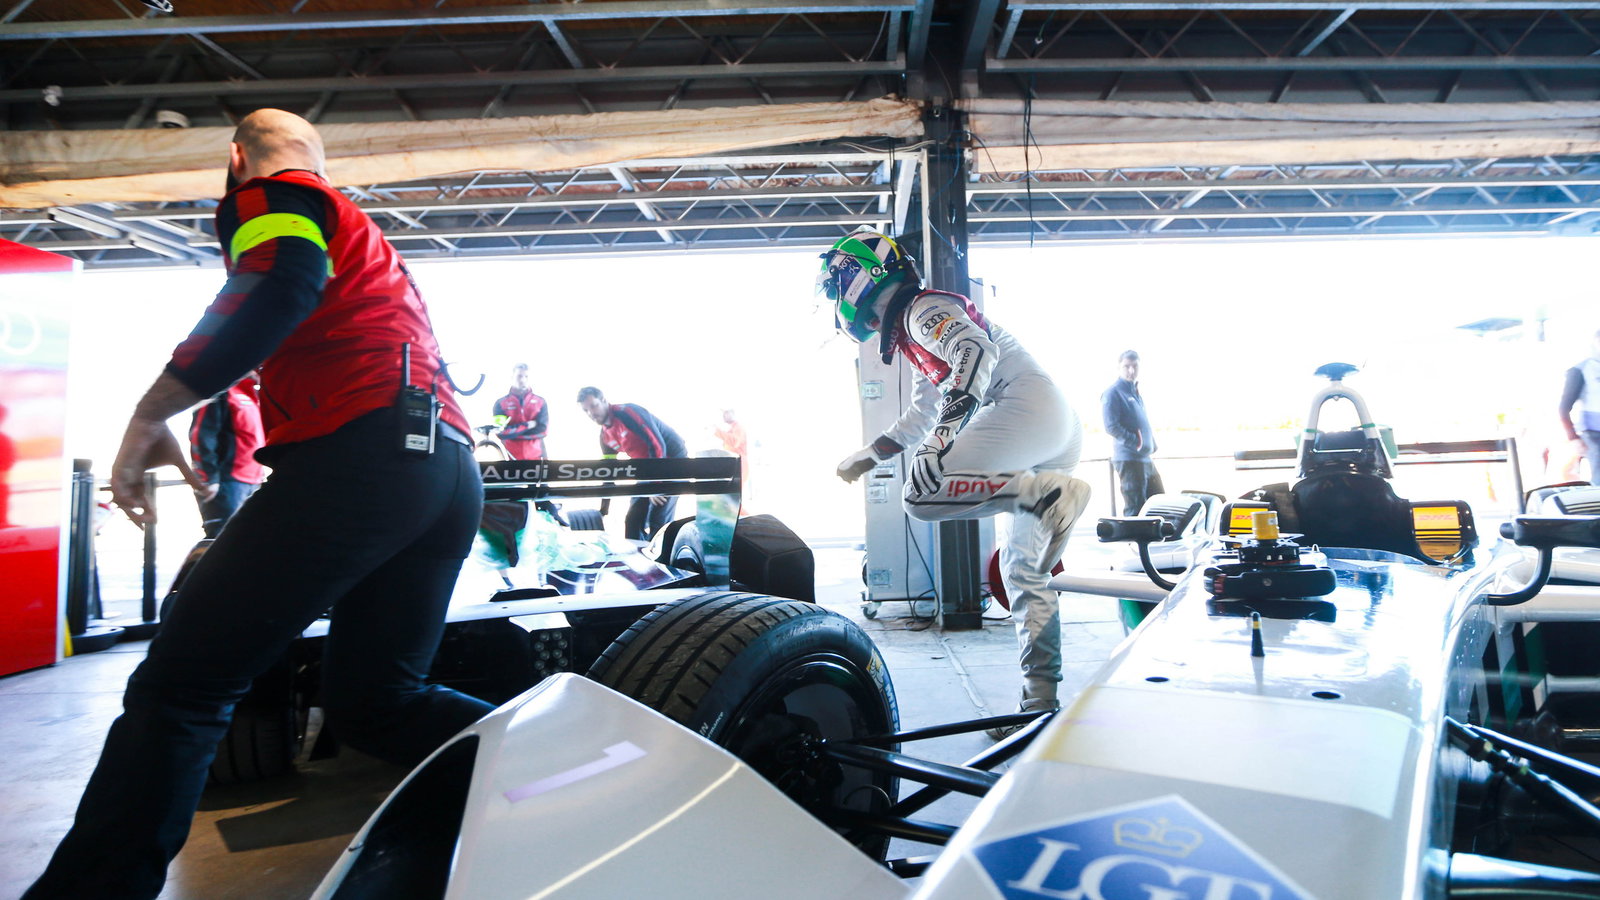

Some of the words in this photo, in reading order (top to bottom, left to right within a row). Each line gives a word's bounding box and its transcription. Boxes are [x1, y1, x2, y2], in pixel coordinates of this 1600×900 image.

[939, 320, 963, 344] KUKA
[957, 346, 973, 375] e-tron
[481, 464, 549, 481] Audi
[556, 463, 638, 481] Sport
